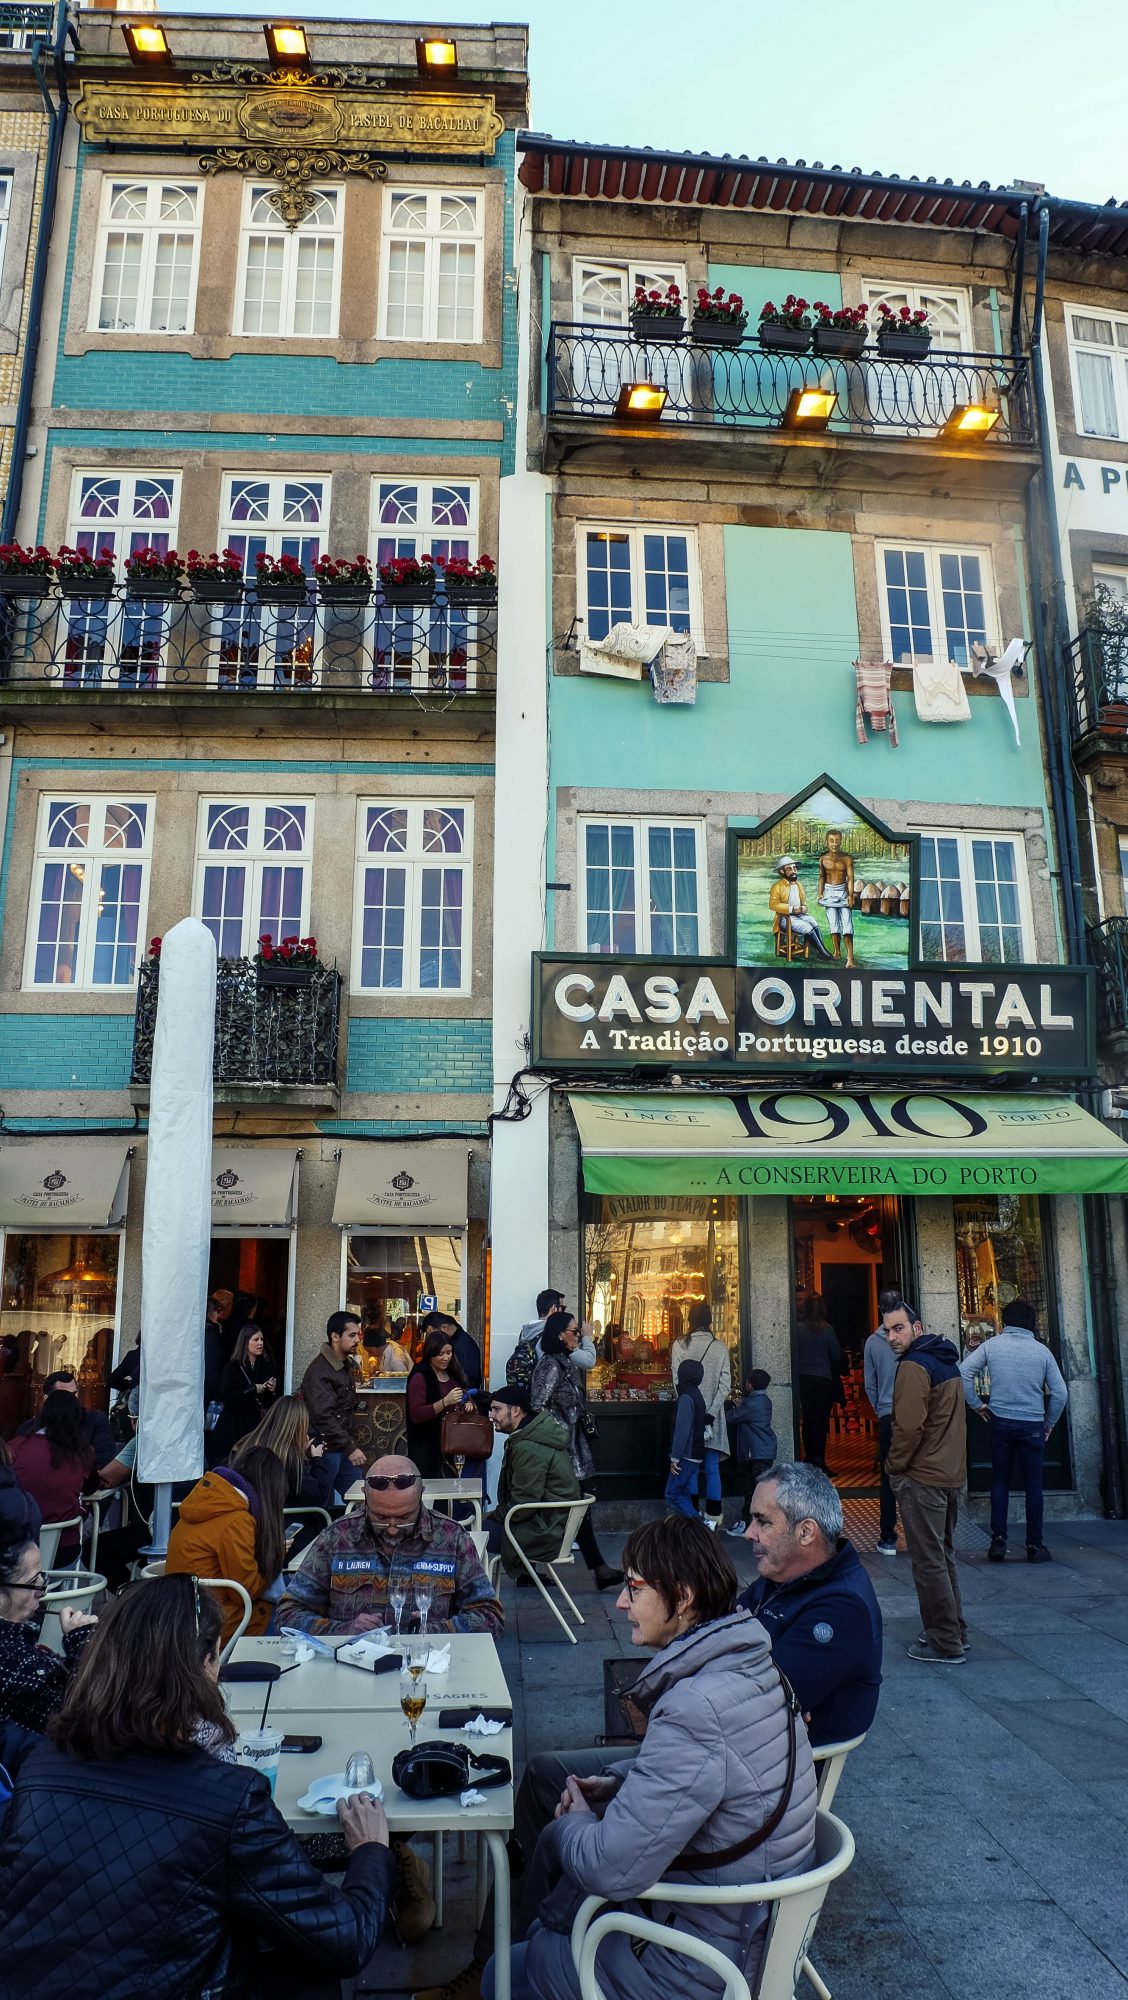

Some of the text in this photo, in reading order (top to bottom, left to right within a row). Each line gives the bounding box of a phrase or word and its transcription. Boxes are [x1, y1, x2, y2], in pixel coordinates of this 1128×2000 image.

[99, 106, 480, 132] CASA PORTUGUESA DO PASTEL DE BACALHAU
[1064, 462, 1128, 494] A P
[554, 973, 1075, 1031] CASA ORIENTAL
[580, 1029, 1042, 1059] A Tradição Portuguesa desde 1910
[604, 1109, 701, 1123] SINCE
[715, 1093, 988, 1145] 1910
[997, 1110, 1071, 1123] PORTO
[716, 1168, 733, 1185] A
[739, 1166, 898, 1185] CONSERVEIRA
[913, 1167, 947, 1185] DO
[960, 1167, 1038, 1185] PORTO
[609, 1195, 706, 1217] O VALOR DO TEMPO
[346, 1561, 371, 1570] LAUREN
